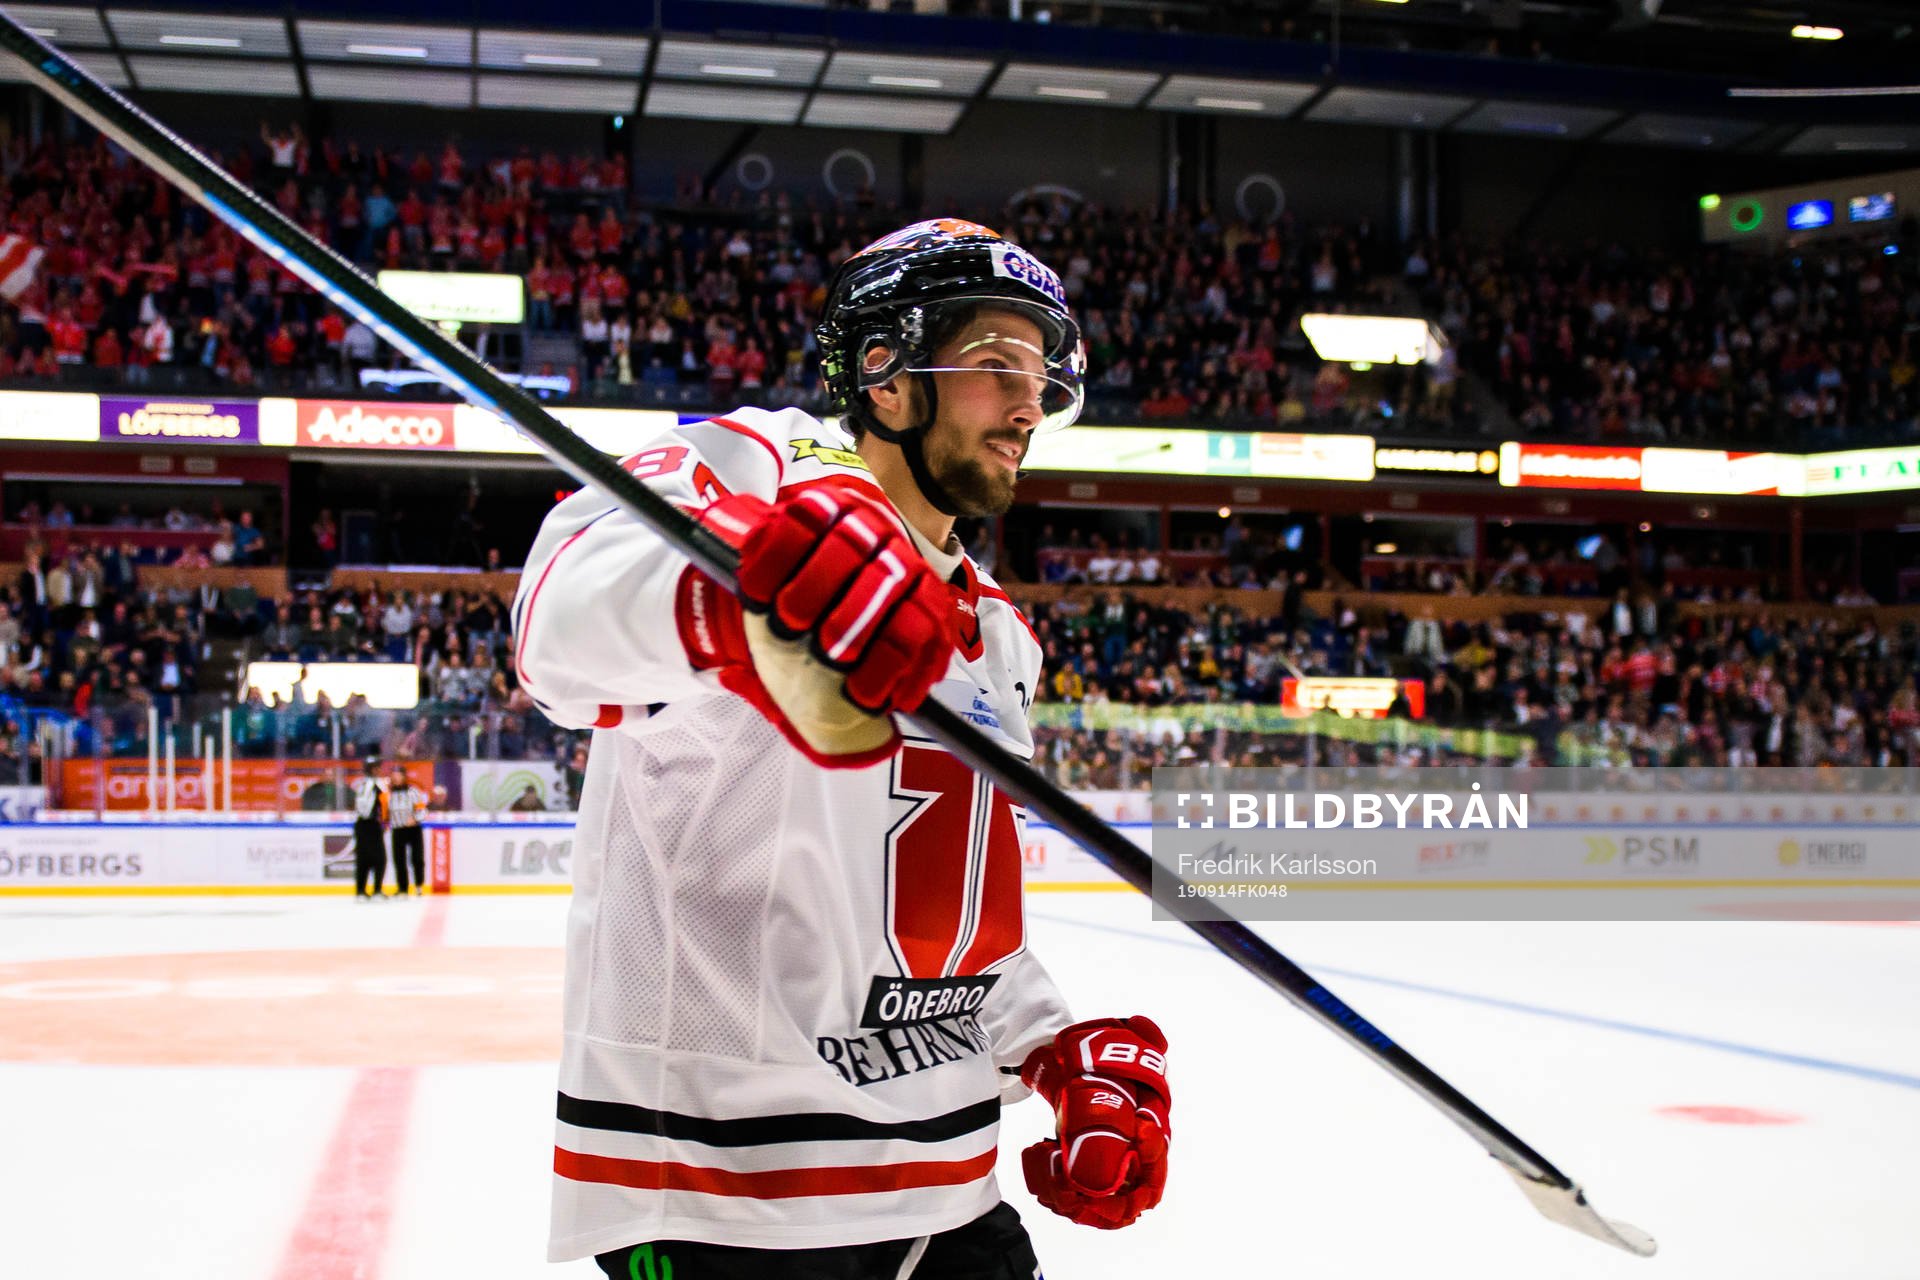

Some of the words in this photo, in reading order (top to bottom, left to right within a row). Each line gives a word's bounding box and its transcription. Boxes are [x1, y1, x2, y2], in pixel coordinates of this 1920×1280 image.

[308, 405, 444, 445] Adecco
[1623, 836, 1699, 866] PSM
[878, 982, 986, 1022] ÖREBRO
